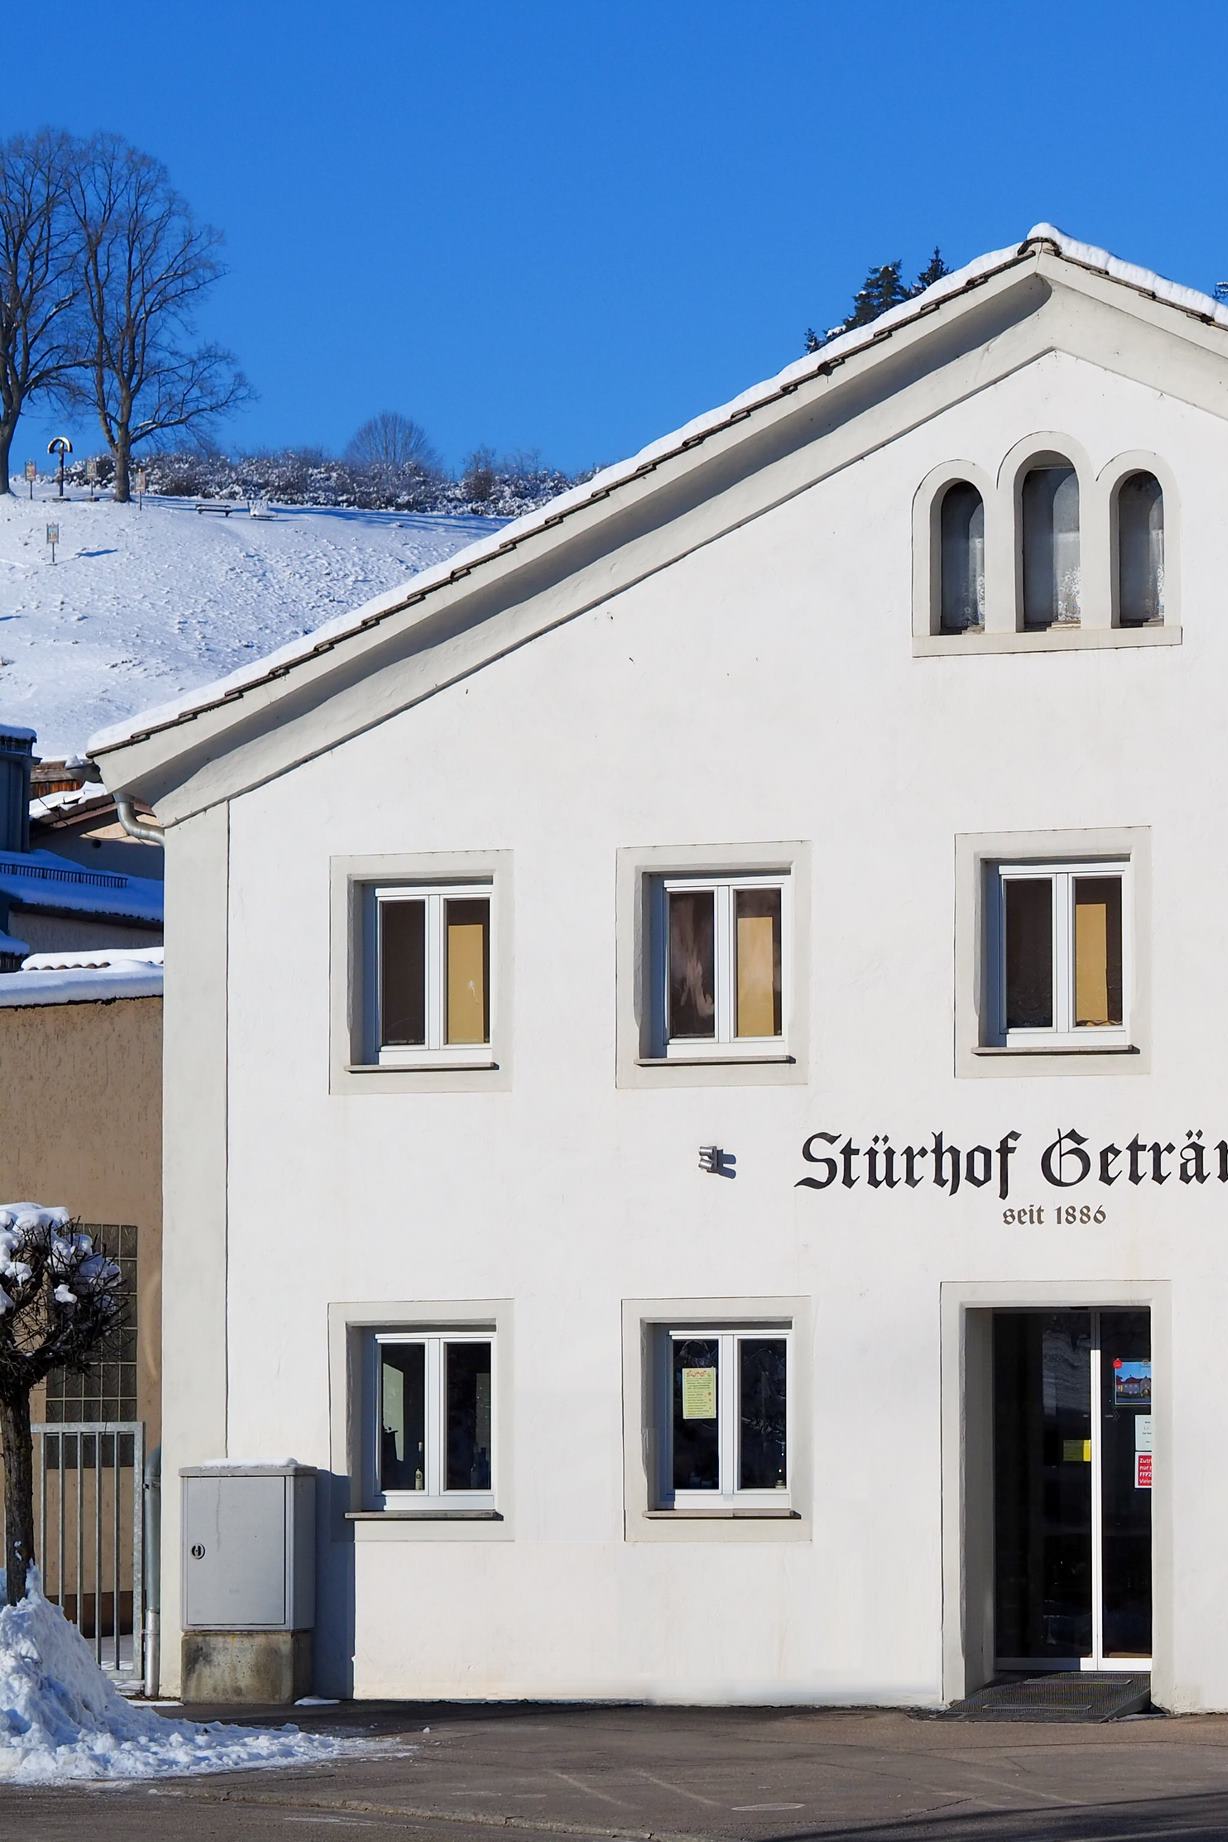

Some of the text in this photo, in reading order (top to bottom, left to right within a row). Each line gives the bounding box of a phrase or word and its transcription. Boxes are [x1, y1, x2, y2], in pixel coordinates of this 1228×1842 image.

[793, 1129, 1023, 1201] Stürhof
[1002, 1204, 1107, 1226] seit 1886
